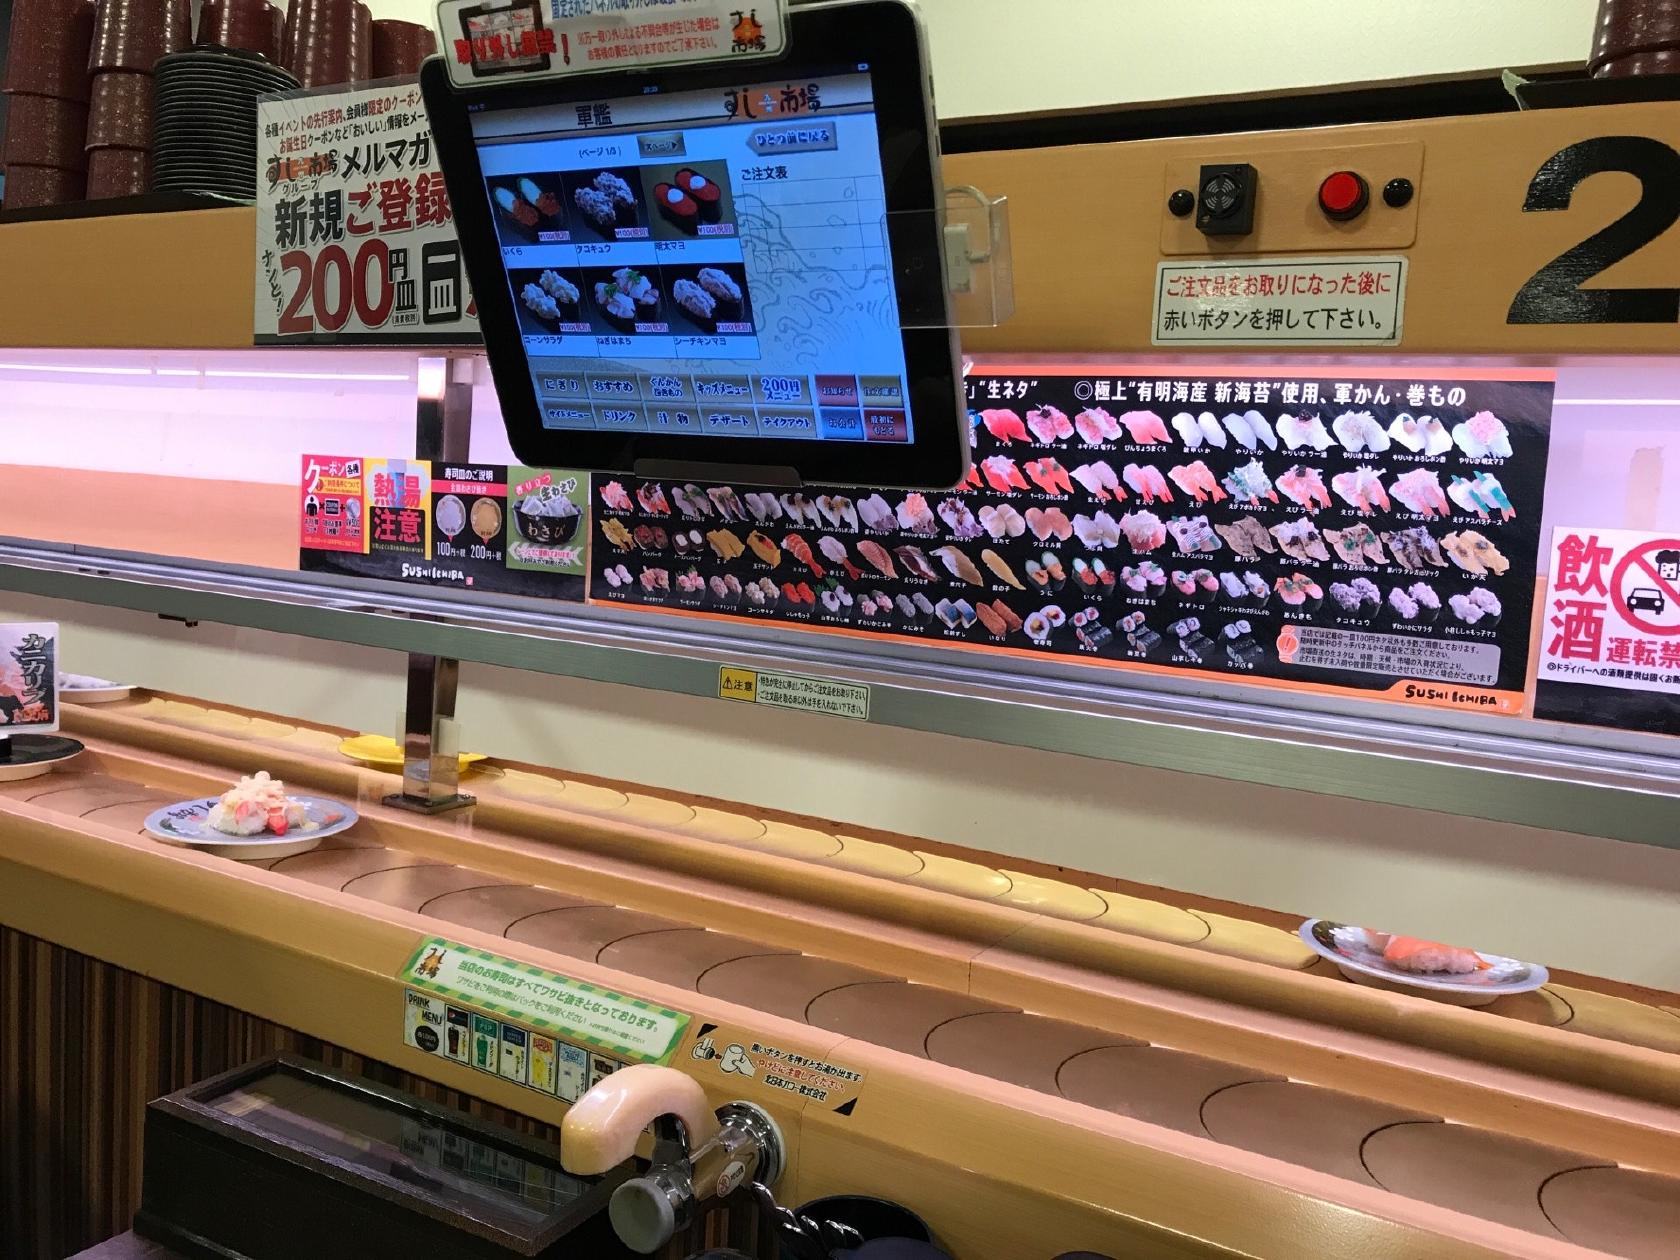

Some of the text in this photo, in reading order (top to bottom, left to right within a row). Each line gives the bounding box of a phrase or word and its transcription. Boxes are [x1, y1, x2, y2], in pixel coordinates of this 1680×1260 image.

[574, 102, 614, 128] 軍艦
[755, 129, 830, 147] ひとつ前に戻る
[341, 130, 432, 179] メルマガ
[740, 165, 789, 182] ご注文表
[274, 171, 454, 250] 新規ご登録
[1506, 135, 1680, 324] 2
[655, 242, 686, 252] 明太マヨ
[1167, 271, 1391, 298] ご注文品をお取りになった後に
[1164, 308, 1382, 331] 赤いボタンを押して下さい。
[524, 336, 563, 345] コーンサラダ
[674, 336, 727, 346] シーチキンマヨ
[545, 378, 580, 391] にぎり
[594, 379, 634, 394] おすすめ
[761, 377, 801, 393] 200円
[767, 391, 802, 401] メニュー
[603, 409, 637, 422] ドリンク
[763, 417, 811, 429] テイクアウト
[445, 468, 493, 481] 寿司皿のご説明
[1395, 512, 1409, 520] えび
[374, 508, 421, 543] 注意
[1548, 534, 1613, 662] 飲酒
[1336, 617, 1371, 626] タコキュウ
[734, 679, 753, 692] 注意
[457, 960, 658, 1033] 当店のお寿司はすべてワサビ抜きとなっております。
[421, 1010, 443, 1025] MENU
